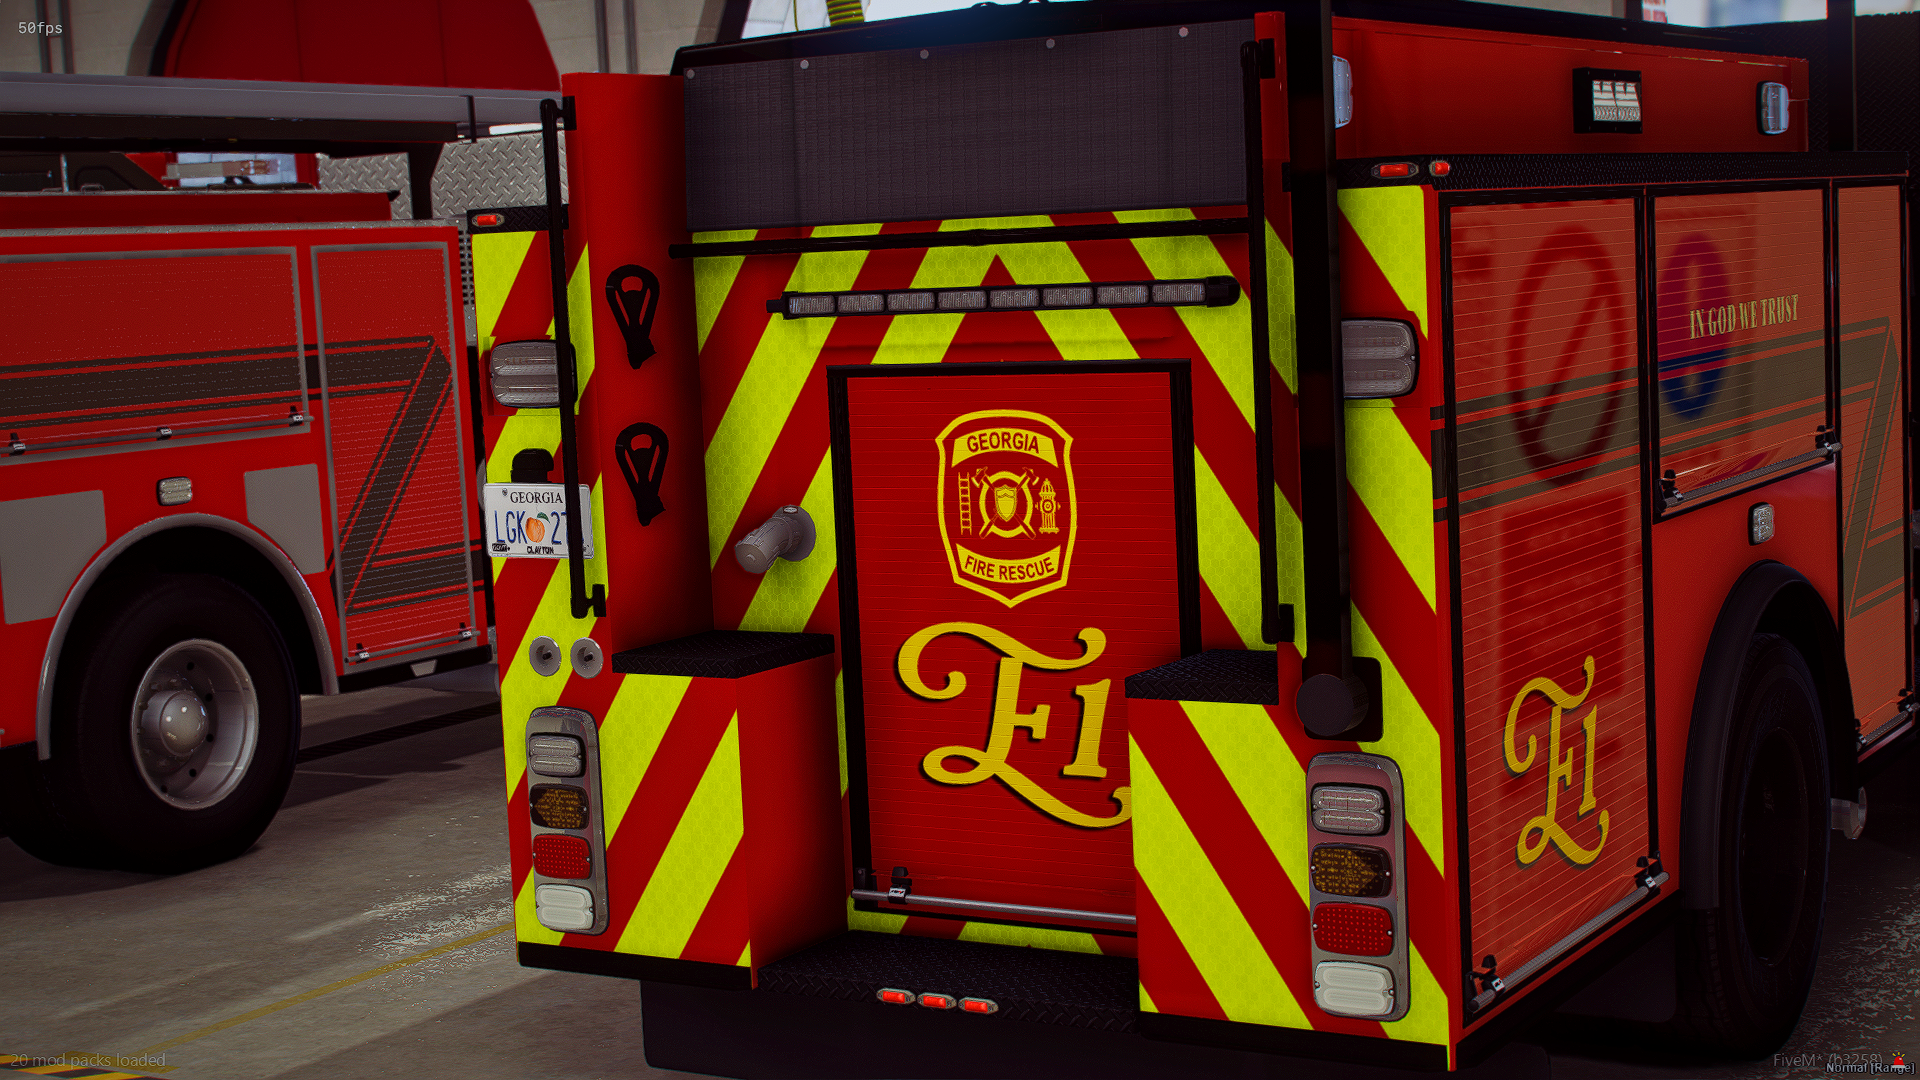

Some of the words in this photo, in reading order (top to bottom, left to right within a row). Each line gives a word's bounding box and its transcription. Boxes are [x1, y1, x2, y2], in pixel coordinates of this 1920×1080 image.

[1689, 308, 1705, 340] IN
[1708, 304, 1737, 337] GOD
[1739, 300, 1758, 331] WE
[1760, 294, 1799, 327] TRUST
[966, 431, 1040, 454] GEORGIA
[510, 491, 563, 504] GEORGIA
[494, 510, 528, 544] LGK
[526, 545, 555, 554] CLAYTON
[964, 554, 995, 579] FIRE
[999, 556, 1055, 581] RESCUE
